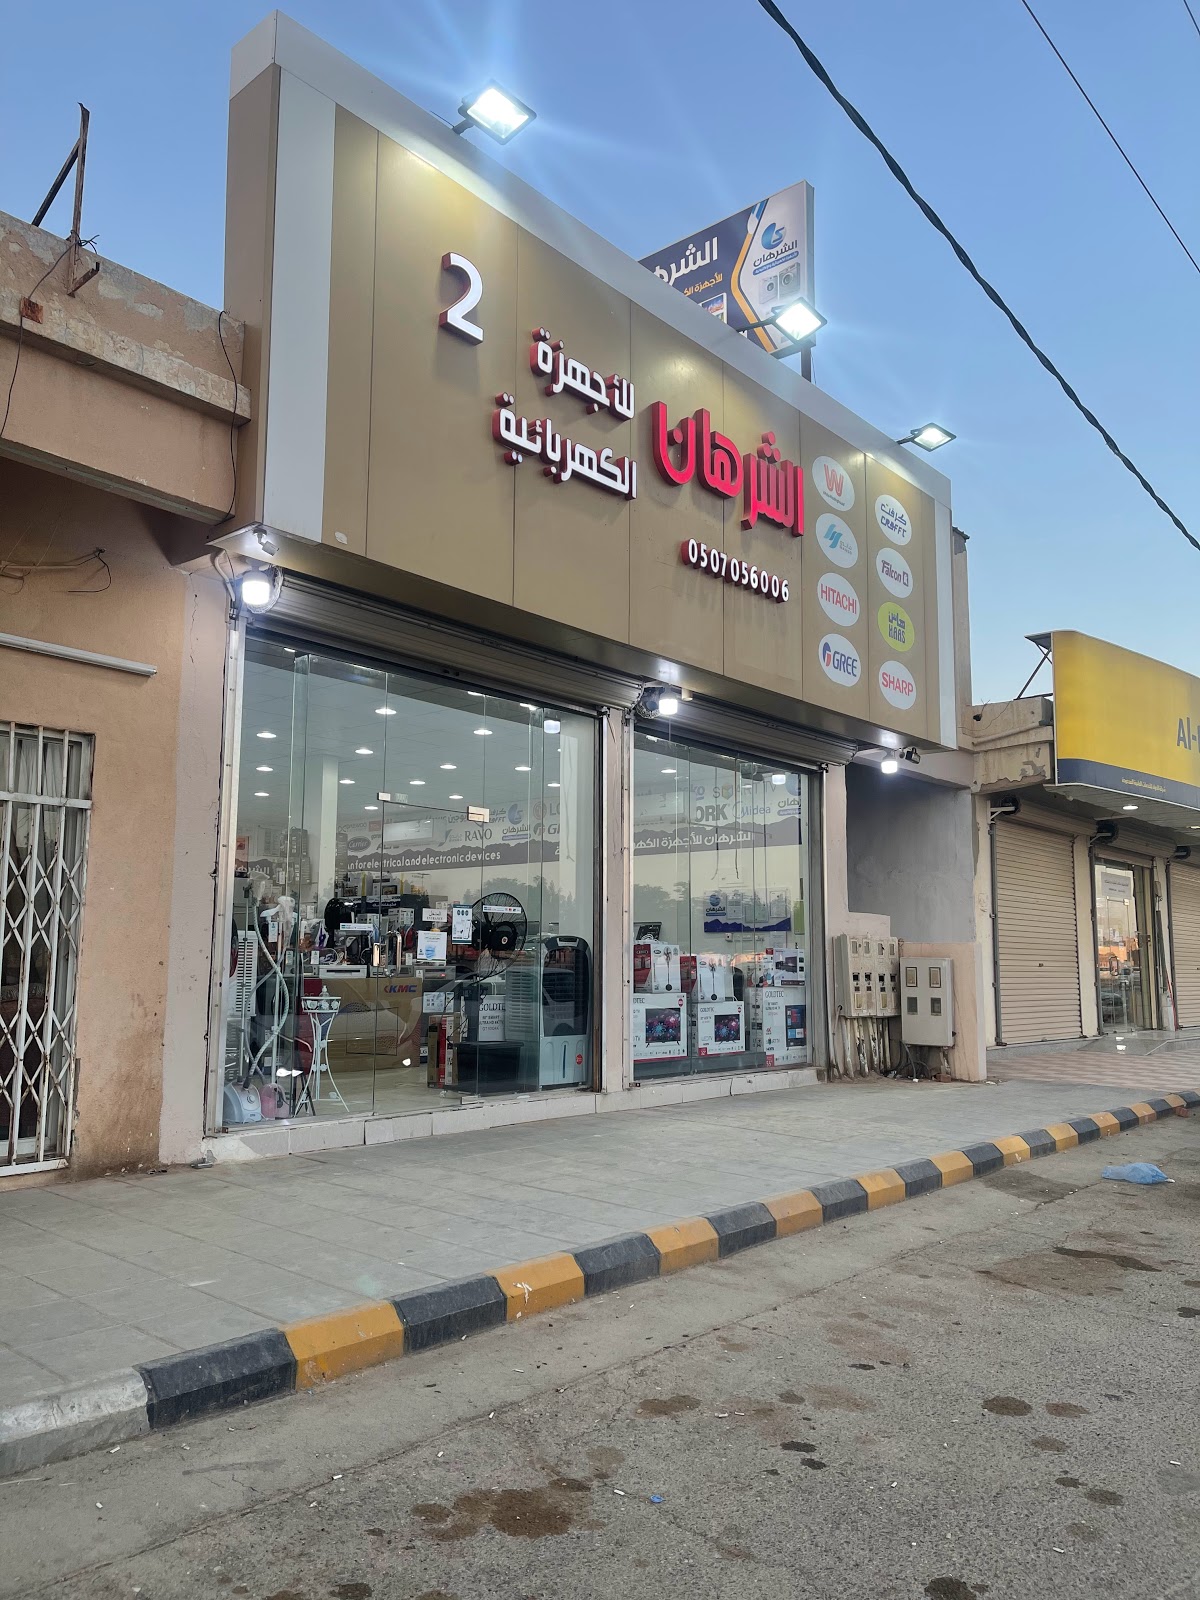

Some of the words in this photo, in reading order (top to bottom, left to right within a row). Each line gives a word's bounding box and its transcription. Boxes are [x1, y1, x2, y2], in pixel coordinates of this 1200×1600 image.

[753, 239, 798, 268] الشرهان
[440, 252, 484, 344] 2
[531, 327, 635, 421] للأجهزة
[493, 392, 638, 501] الكهربائية
[652, 401, 804, 537] الشرهان
[682, 538, 789, 602] 0507056006
[881, 559, 902, 583] Falcon
[820, 583, 857, 615] HITACHI
[832, 650, 858, 678] GREE
[881, 671, 914, 696] SHARP
[695, 803, 728, 823] ORK
[405, 854, 421, 866] and
[421, 851, 465, 865] electronic
[465, 850, 501, 862] devices
[389, 984, 417, 993] KMC
